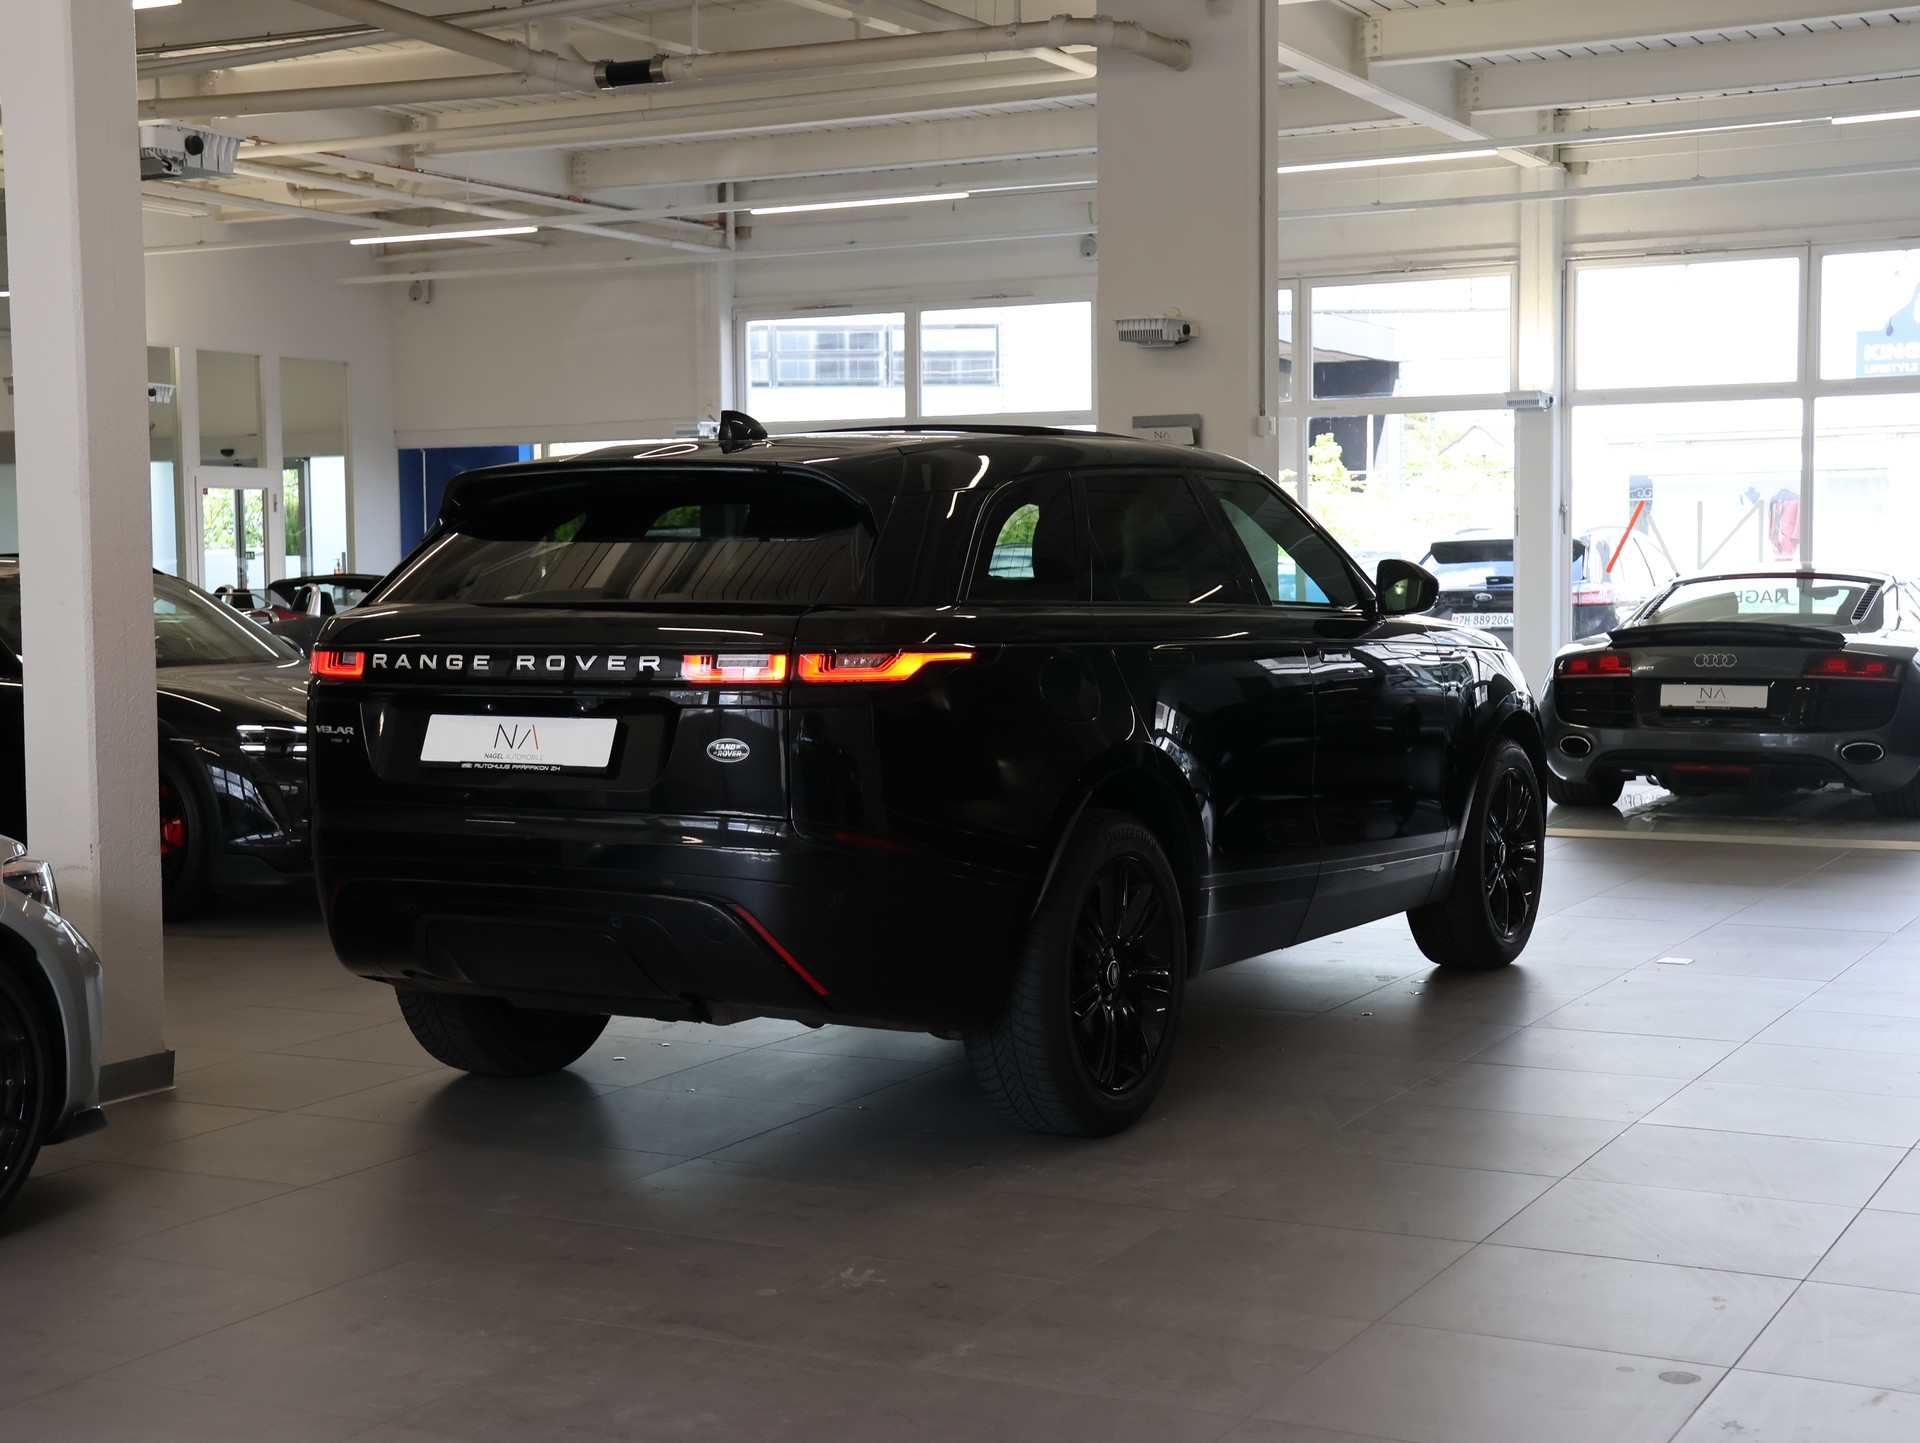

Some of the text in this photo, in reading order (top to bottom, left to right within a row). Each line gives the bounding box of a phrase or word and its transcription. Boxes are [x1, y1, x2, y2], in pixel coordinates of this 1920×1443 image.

[372, 652, 661, 673] RANGE ROVER
[315, 724, 354, 735] VELAR
[494, 724, 539, 750] NA
[483, 752, 545, 761] NAGEL AUTOMOBILE
